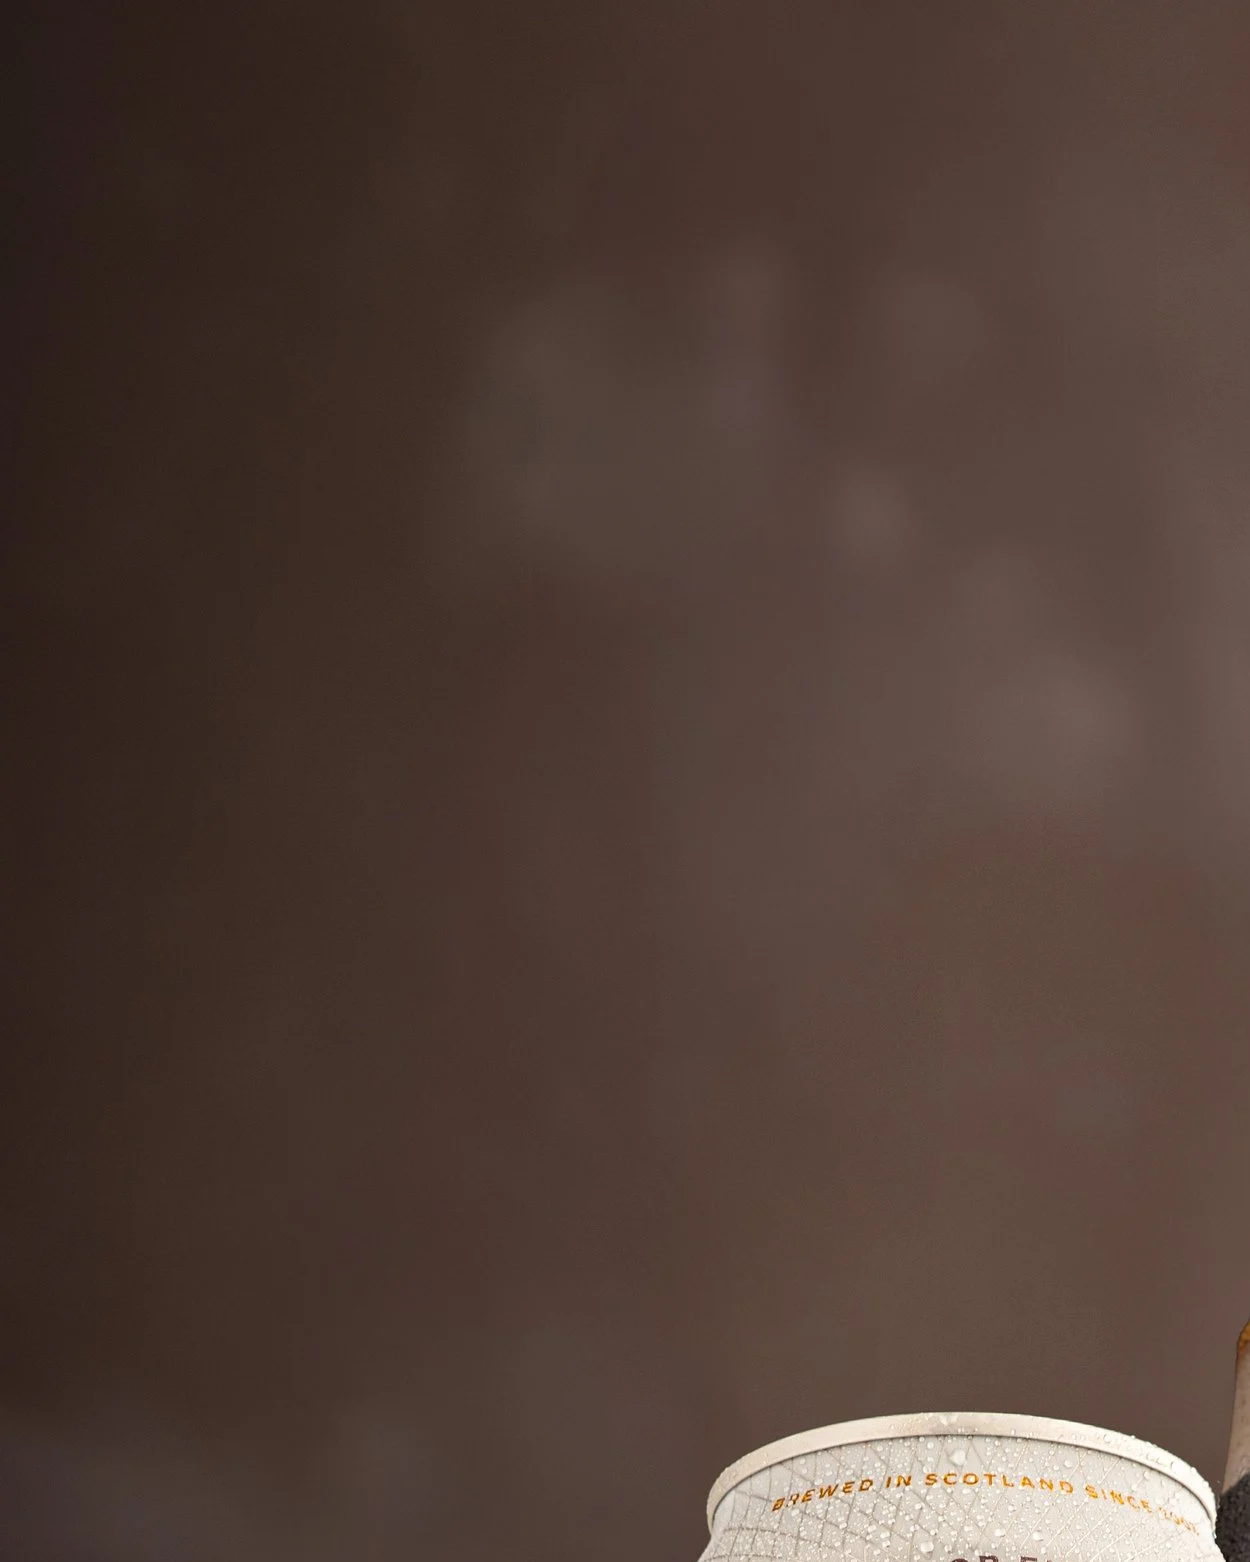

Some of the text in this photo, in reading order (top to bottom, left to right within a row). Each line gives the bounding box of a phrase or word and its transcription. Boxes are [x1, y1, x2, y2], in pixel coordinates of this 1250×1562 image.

[771, 1473, 1153, 1513] BREWED IN SCOTLAND SINCE
